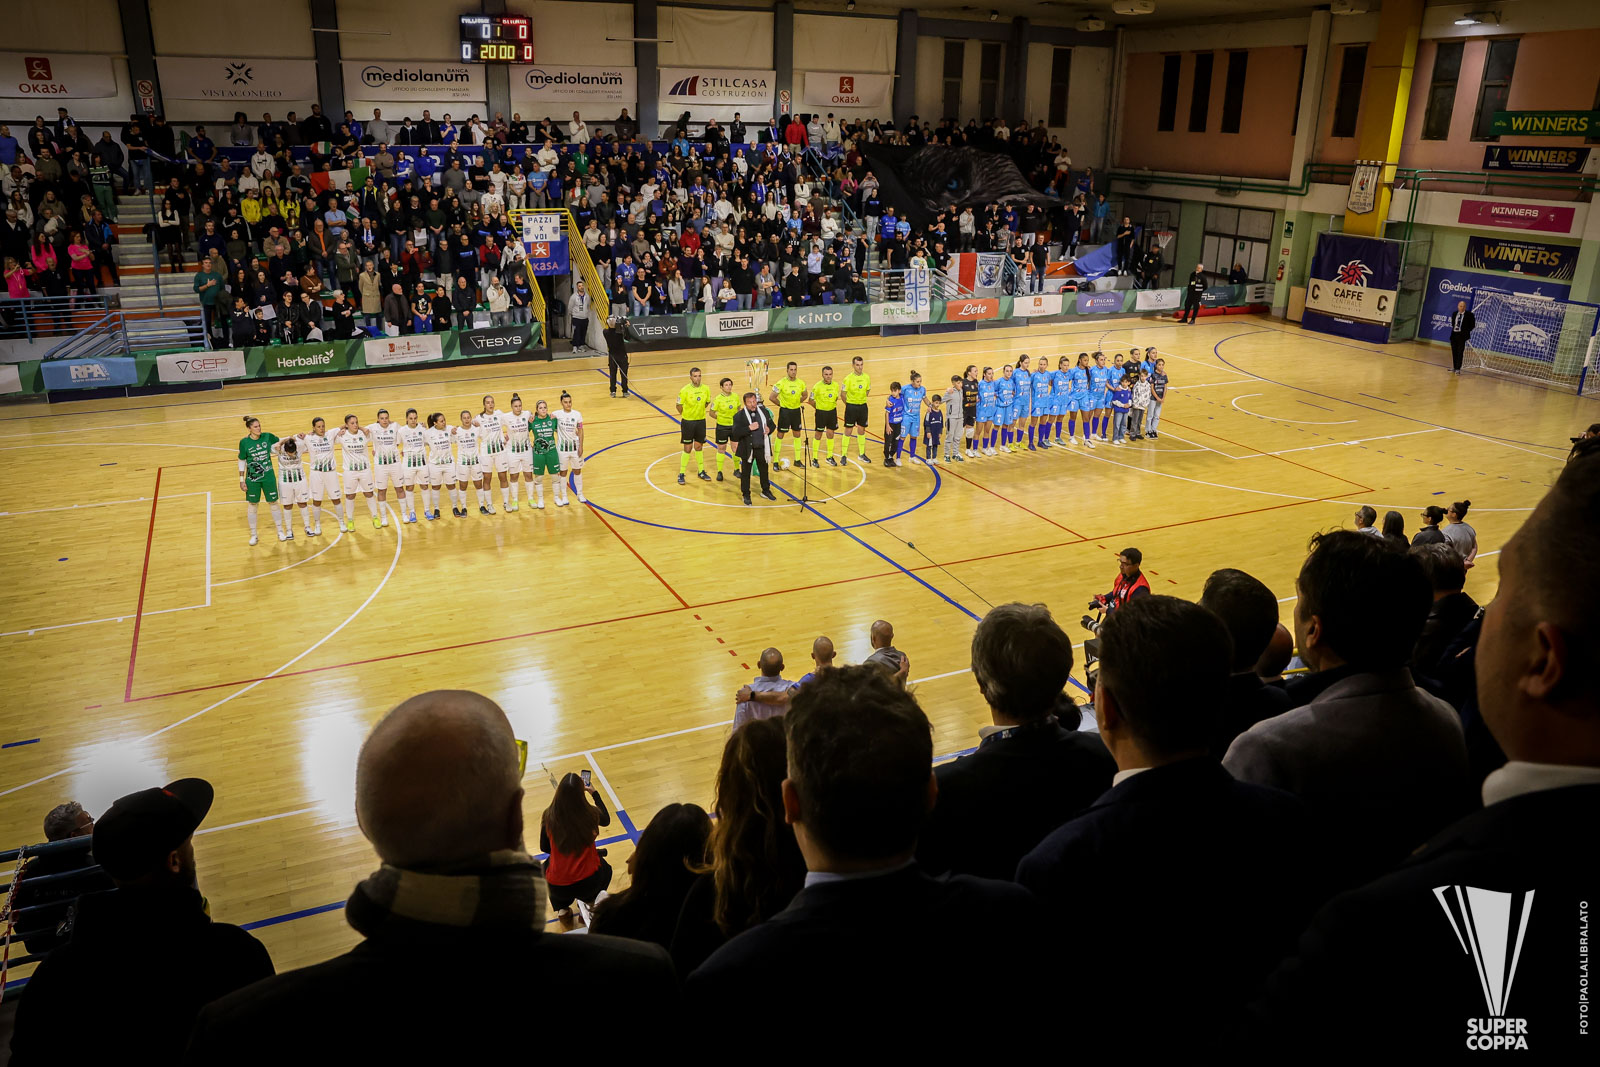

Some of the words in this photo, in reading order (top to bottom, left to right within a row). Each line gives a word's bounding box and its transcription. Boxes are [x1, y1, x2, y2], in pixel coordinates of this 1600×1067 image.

[482, 24, 490, 38] 0
[519, 25, 527, 38] 0
[463, 44, 471, 58] 0
[524, 46, 532, 59] 0
[366, 69, 469, 82] mediolanum
[530, 72, 622, 85] mediolanum
[702, 78, 767, 88] STILCASA
[201, 89, 283, 97] VISTACONERO
[702, 89, 767, 97] COSTRUZIONI
[1511, 117, 1589, 132] WINNERS
[1507, 149, 1577, 164] WINNERS
[1491, 206, 1539, 217] WINNERS
[1483, 244, 1562, 267] WINNERS
[1311, 284, 1320, 300] C
[958, 303, 987, 316] Lete
[1377, 295, 1388, 311] C
[720, 317, 754, 330] MUNICH
[639, 326, 679, 335] TESYS
[477, 336, 522, 348] TESYS
[190, 358, 228, 370] GEP
[277, 354, 330, 369] Herbalife
[70, 364, 107, 379] RPA
